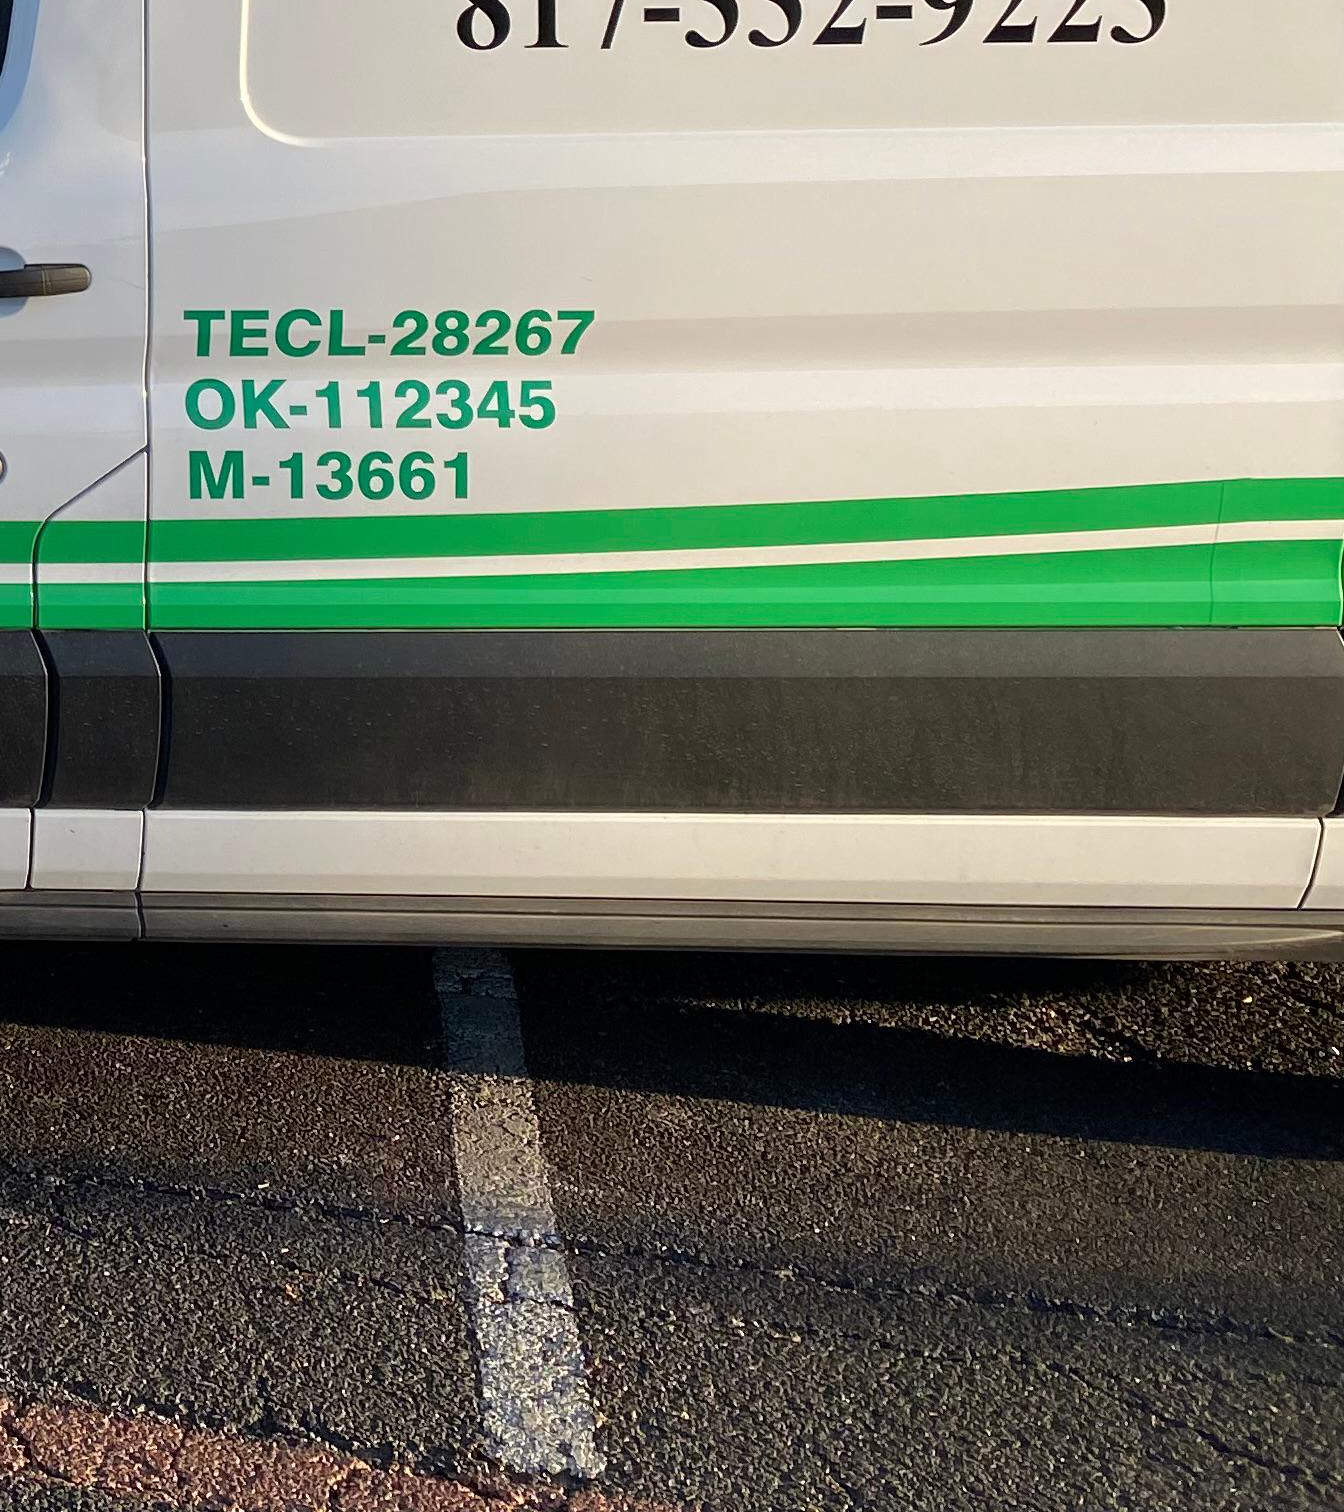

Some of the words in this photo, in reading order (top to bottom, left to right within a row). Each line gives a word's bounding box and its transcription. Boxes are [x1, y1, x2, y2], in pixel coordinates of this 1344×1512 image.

[183, 308, 596, 358] TECL-28267
[185, 378, 557, 430] OK-112345
[188, 450, 471, 501] M-13661
